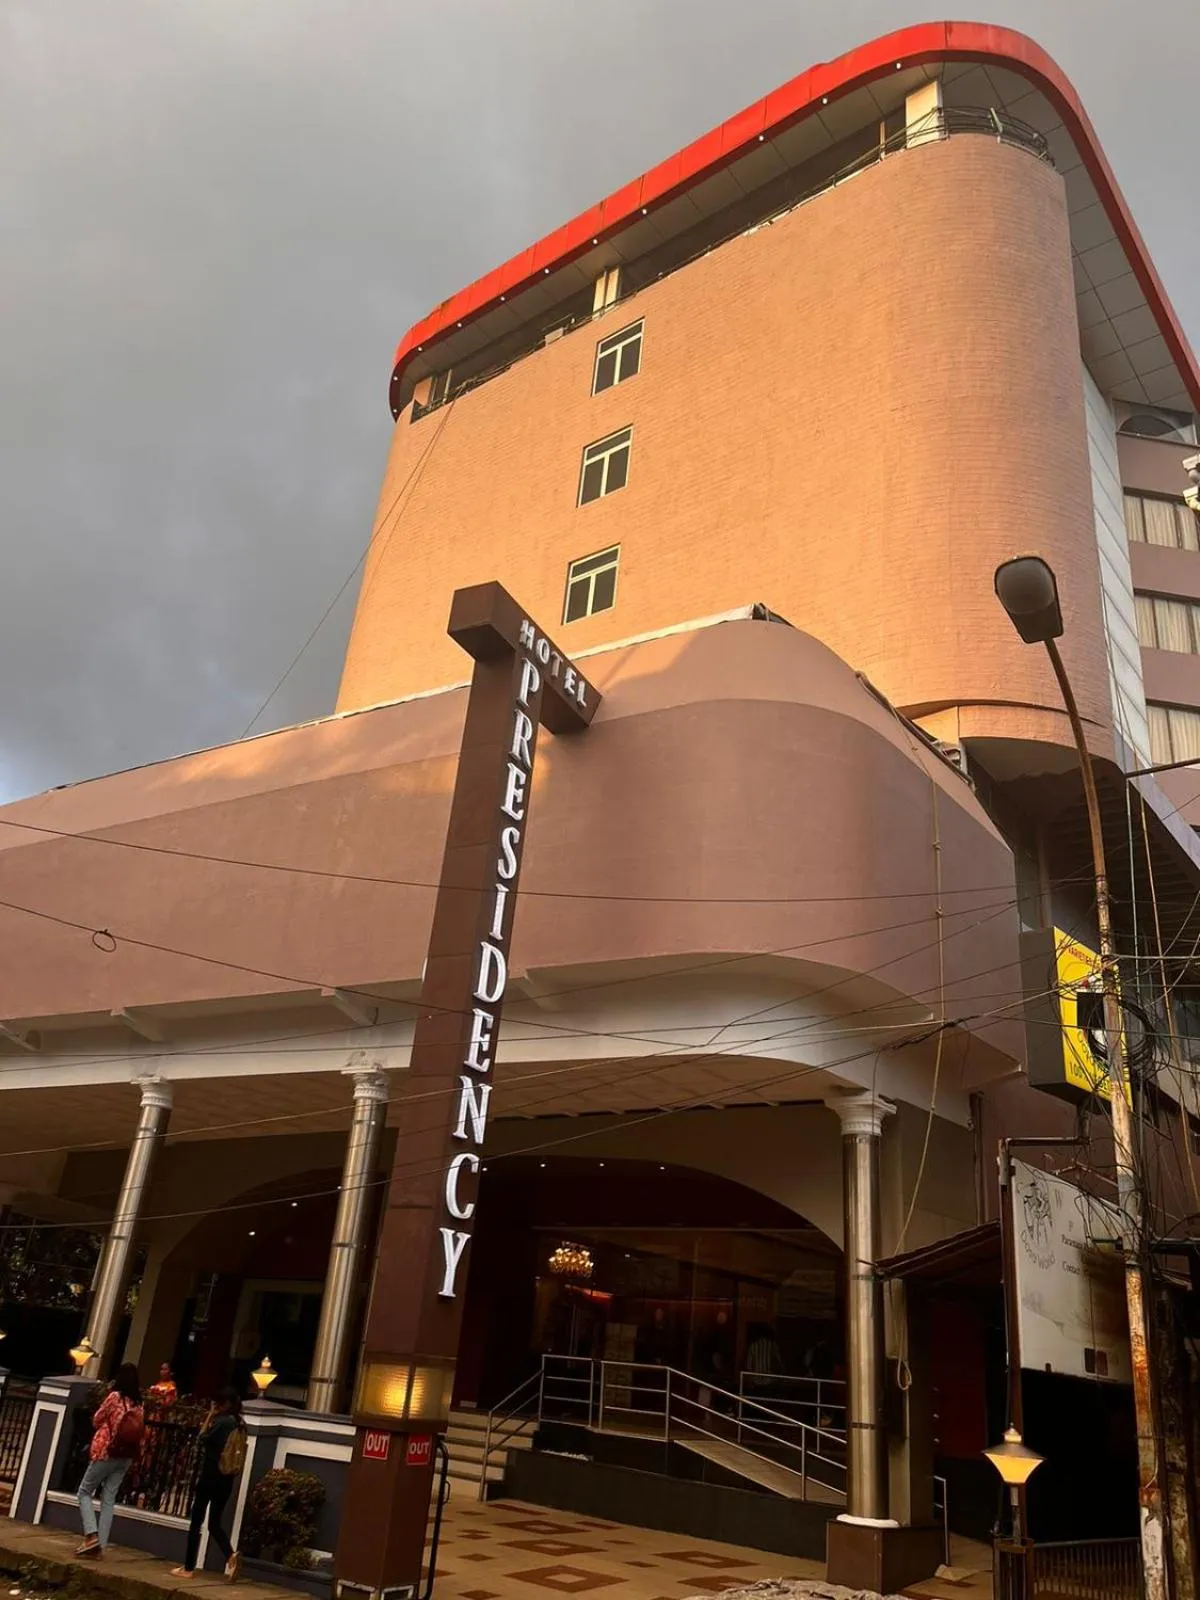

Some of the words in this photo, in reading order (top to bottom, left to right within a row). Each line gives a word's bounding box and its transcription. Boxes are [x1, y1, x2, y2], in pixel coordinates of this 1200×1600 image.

[519, 619, 587, 708] HOTEL
[438, 657, 540, 1298] PRESIDENCY
[366, 1432, 390, 1453] OUT
[409, 1441, 430, 1455] OUT
